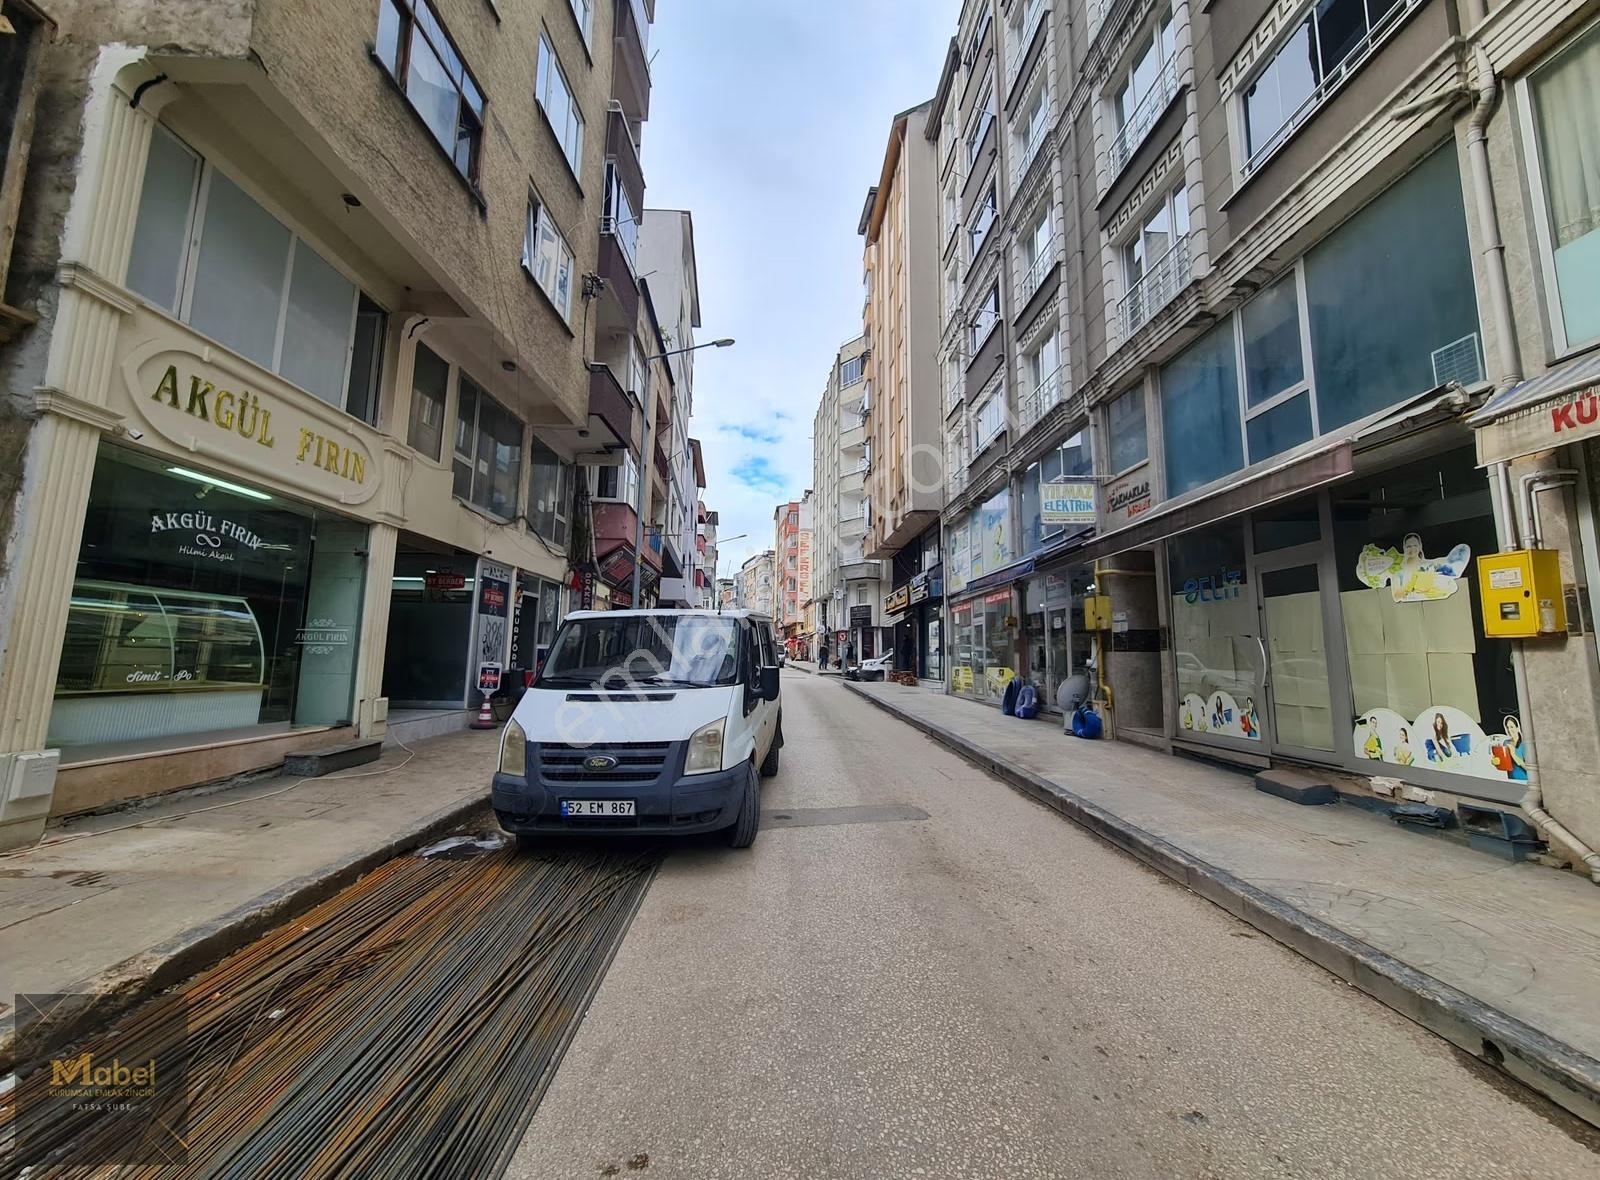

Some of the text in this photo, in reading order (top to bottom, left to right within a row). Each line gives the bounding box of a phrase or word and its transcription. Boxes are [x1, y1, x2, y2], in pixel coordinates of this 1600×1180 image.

[1552, 391, 1600, 433] KÜ
[151, 365, 367, 484] AKGÜL FIRIN
[1042, 484, 1094, 499] YILMAZ
[151, 510, 262, 550] AKGÜL FIRIN
[178, 545, 235, 561] Hilmi Akgül
[295, 631, 325, 641] AKGÜL
[126, 670, 161, 682] Simit
[590, 758, 608, 767] Ford
[568, 802, 633, 813] 52 EM 867
